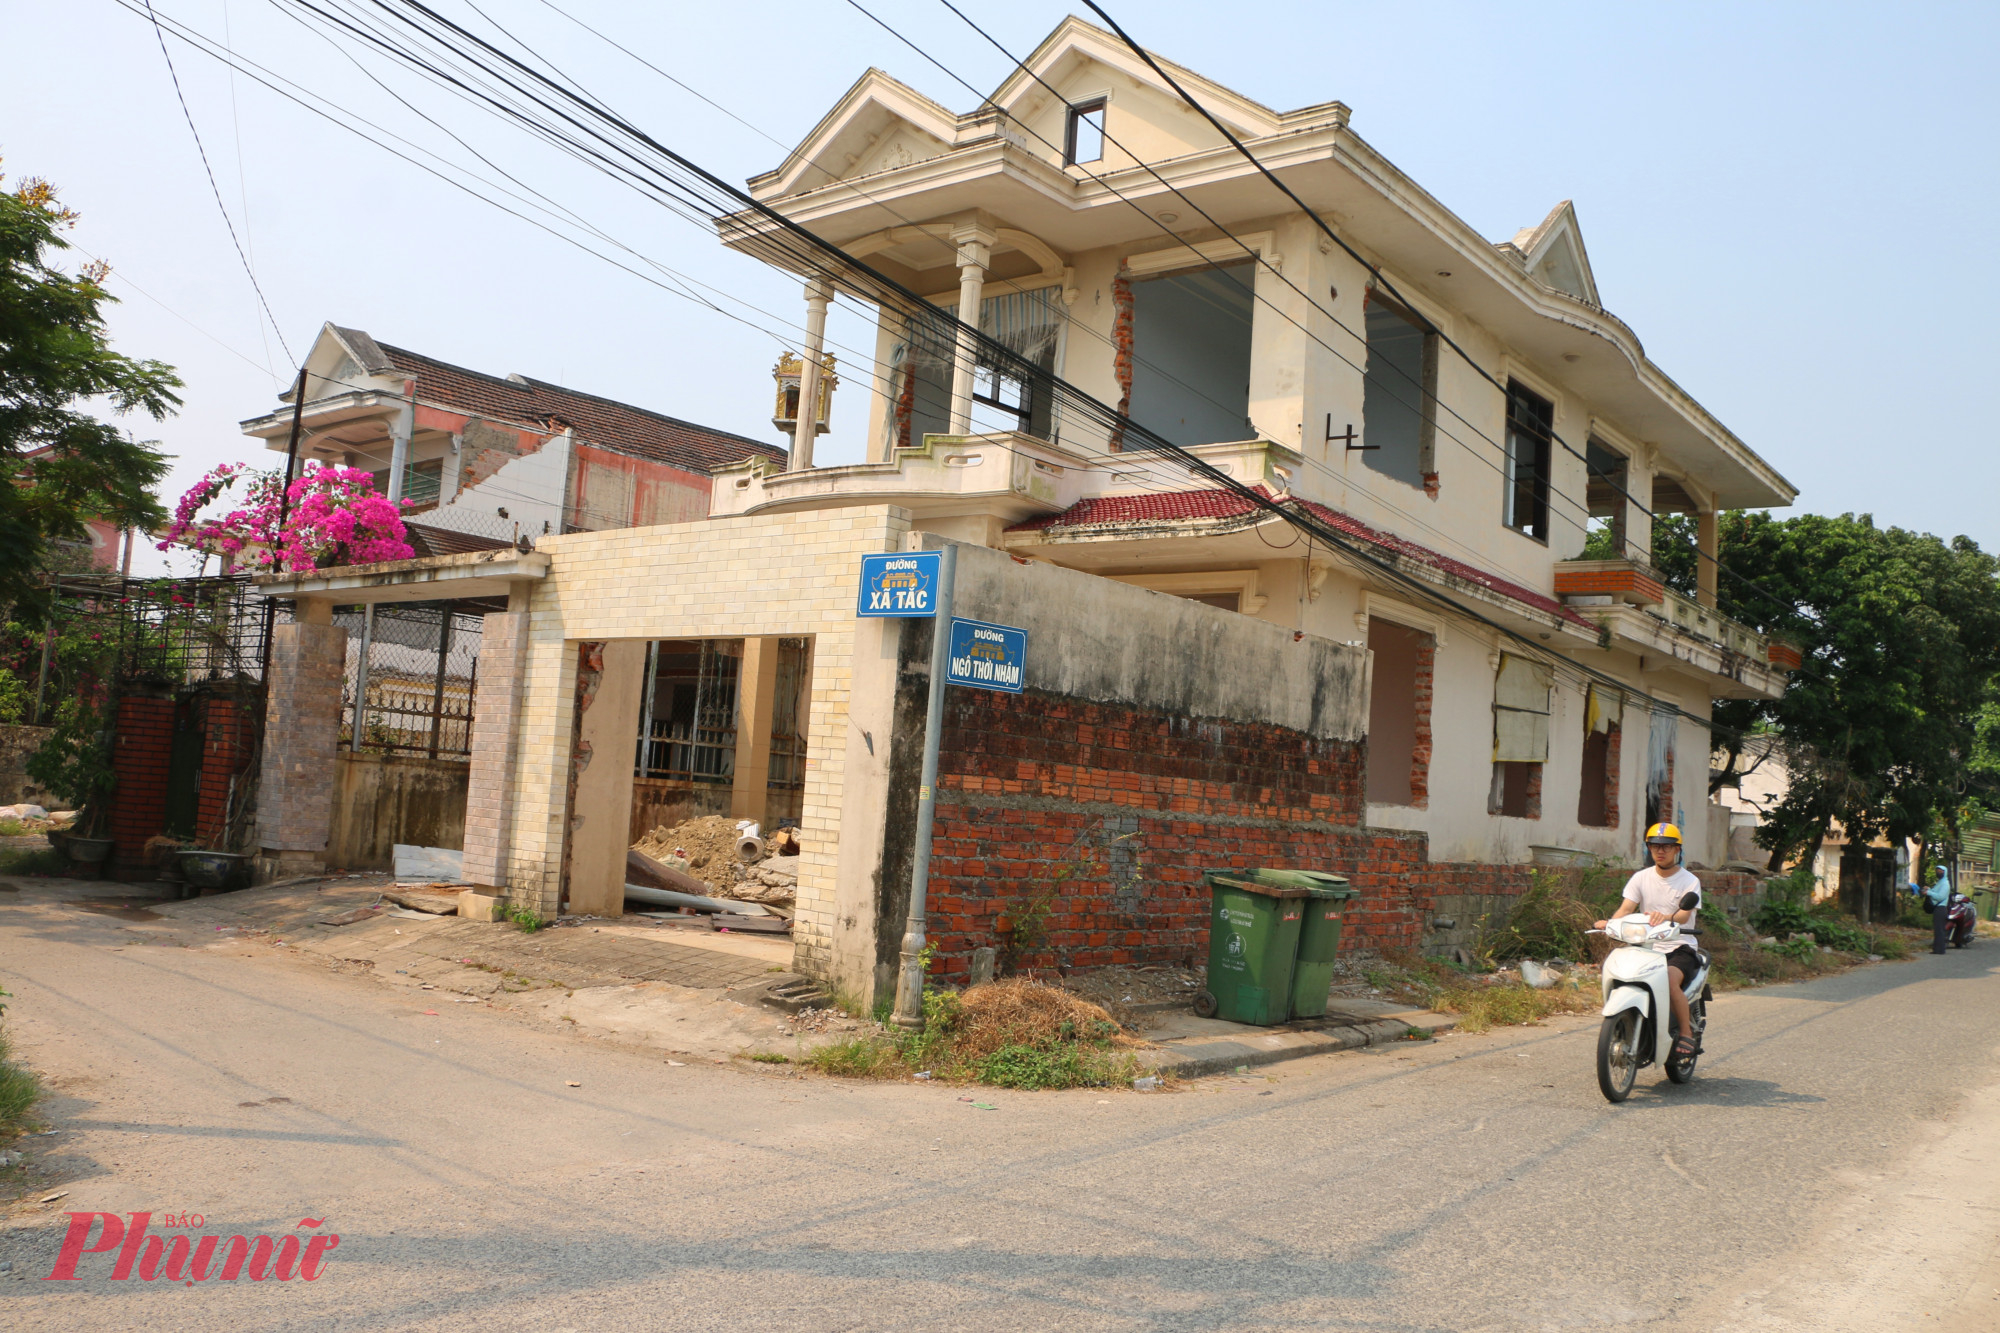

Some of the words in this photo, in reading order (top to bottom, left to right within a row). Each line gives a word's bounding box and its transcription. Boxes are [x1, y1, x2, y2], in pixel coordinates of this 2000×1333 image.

[886, 559, 917, 570] ĐƯỜNG
[869, 587, 891, 609] XÃ
[896, 583, 928, 609] TẮC
[974, 629, 1004, 642] ĐƯỜNG
[952, 655, 971, 677] NGÔ
[973, 657, 994, 680] THỜI
[994, 662, 1019, 686] NHẬM
